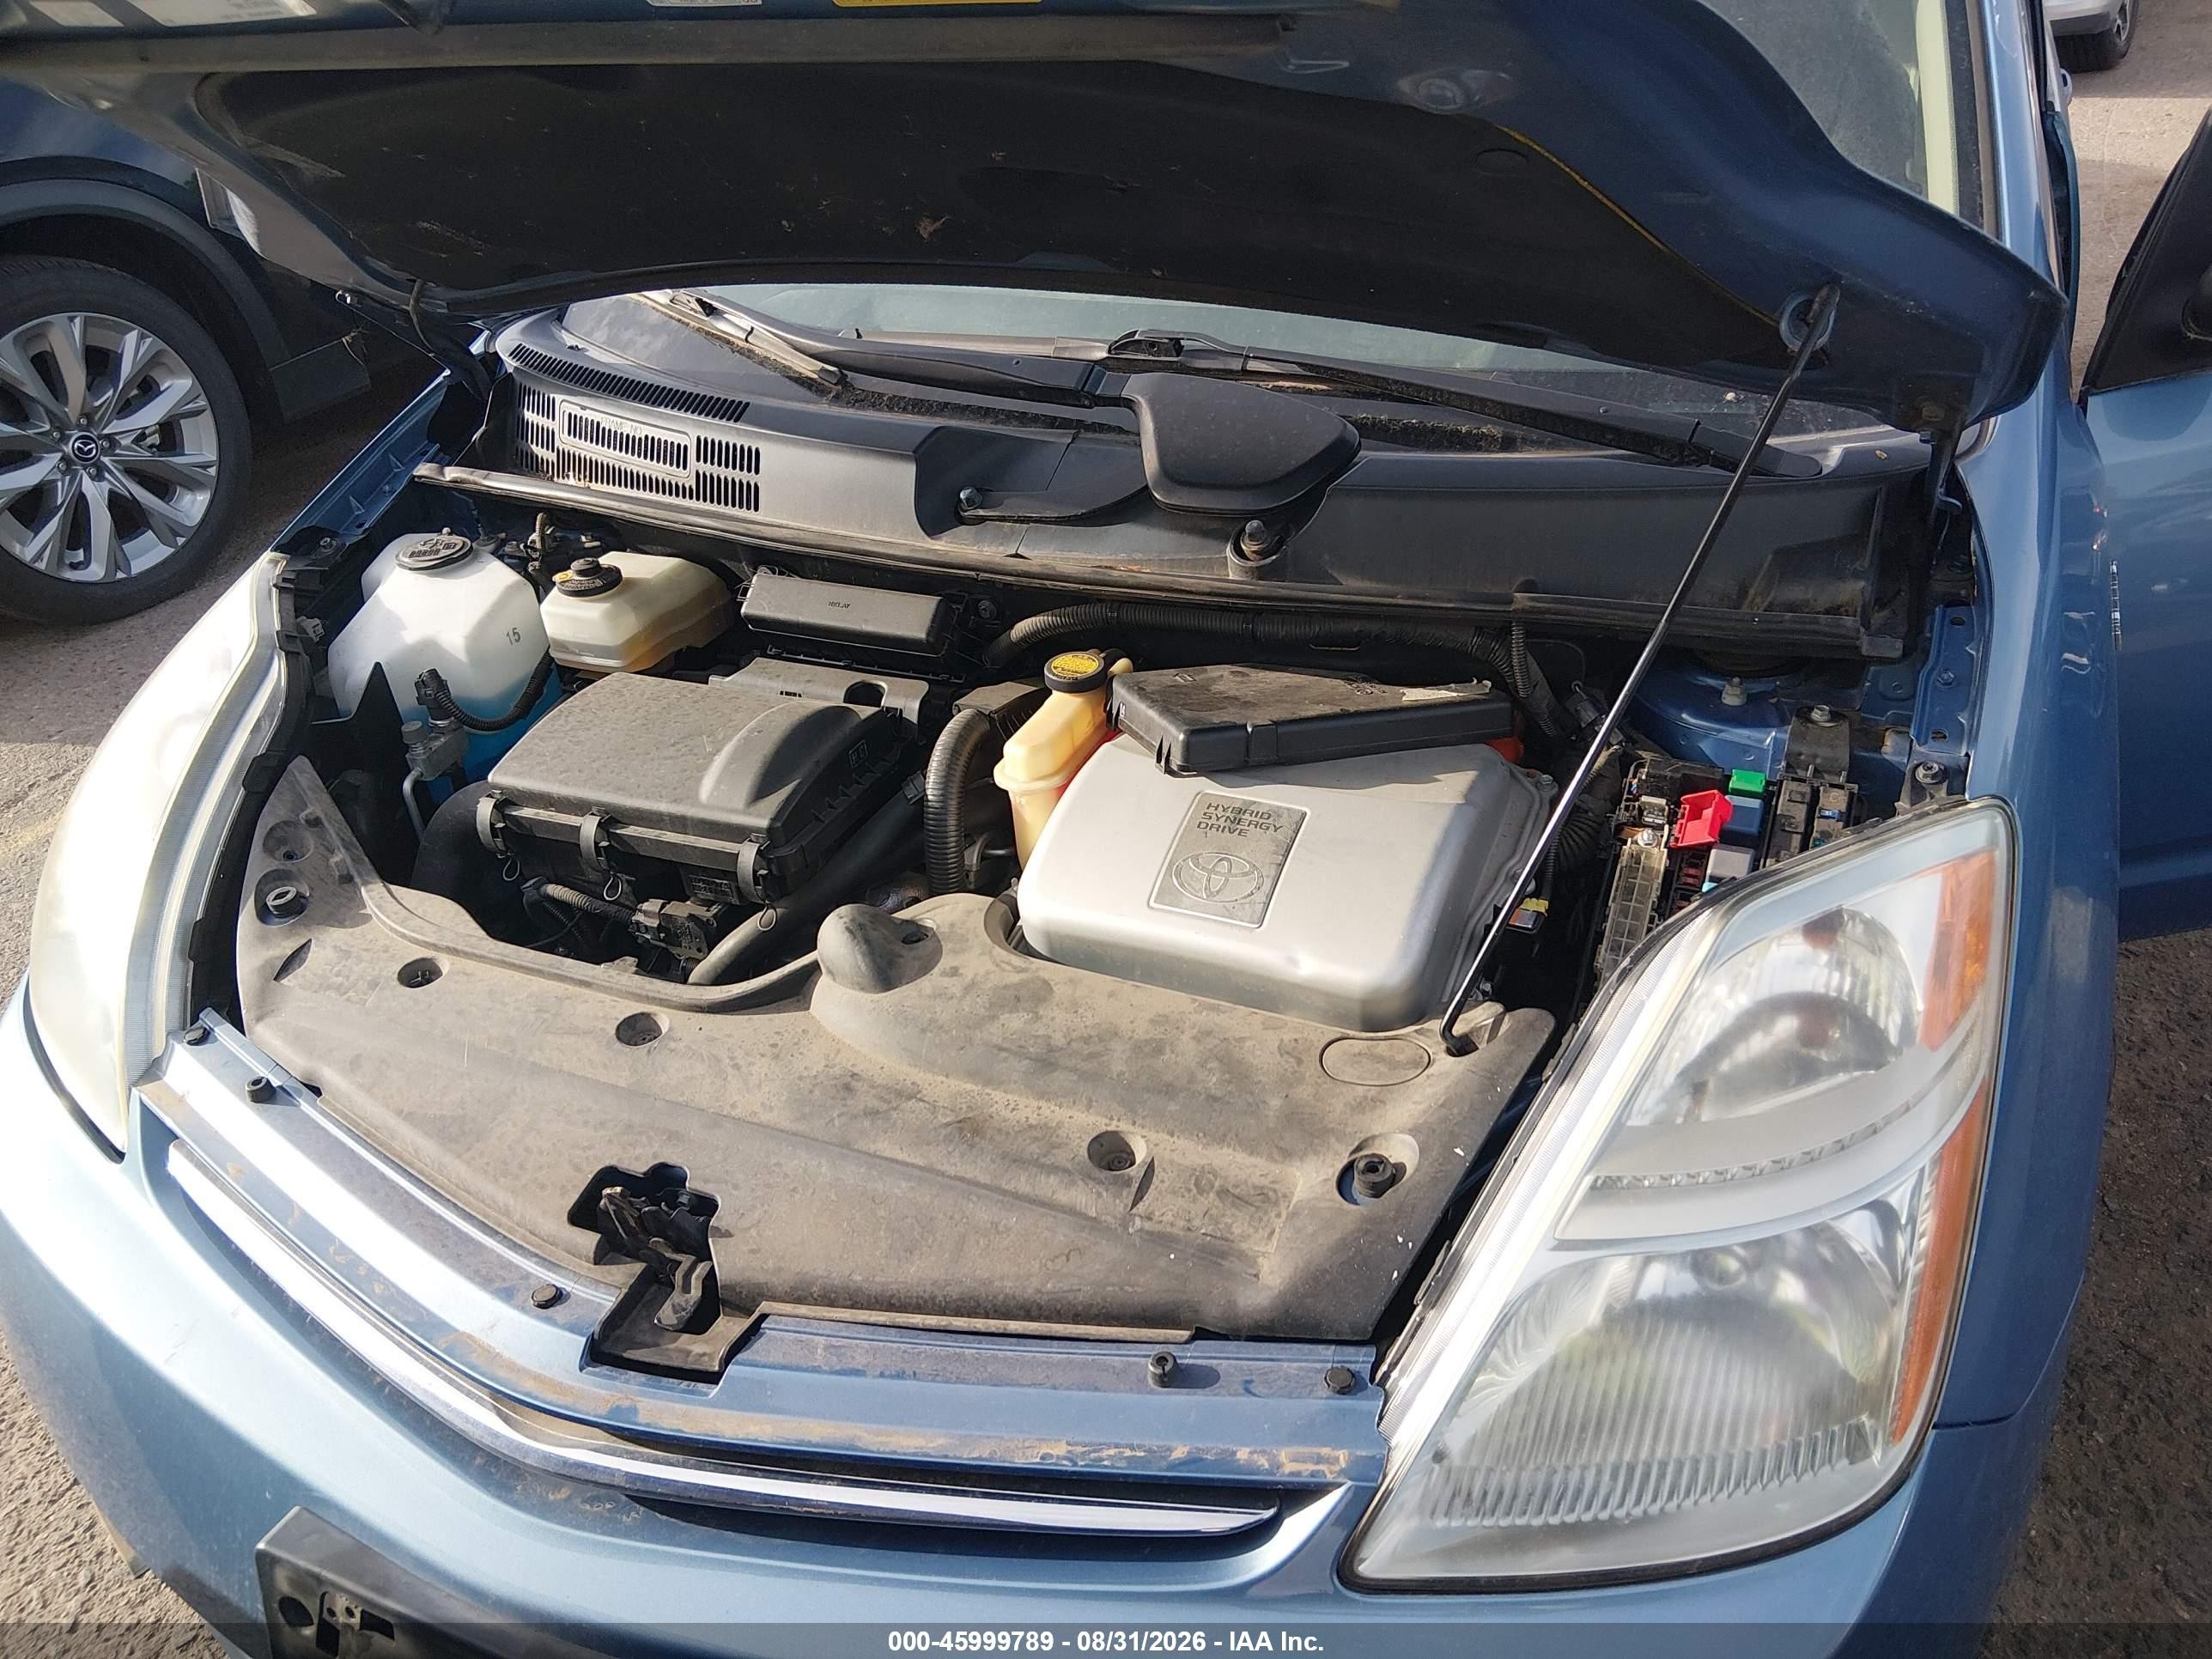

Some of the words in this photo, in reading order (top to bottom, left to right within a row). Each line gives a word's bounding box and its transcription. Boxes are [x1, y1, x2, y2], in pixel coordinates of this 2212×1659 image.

[507, 627, 521, 646] 15
[1206, 802, 1272, 820] HYBRID
[1196, 821, 1250, 837] DRIVE
[1201, 811, 1285, 833] SYNERGY
